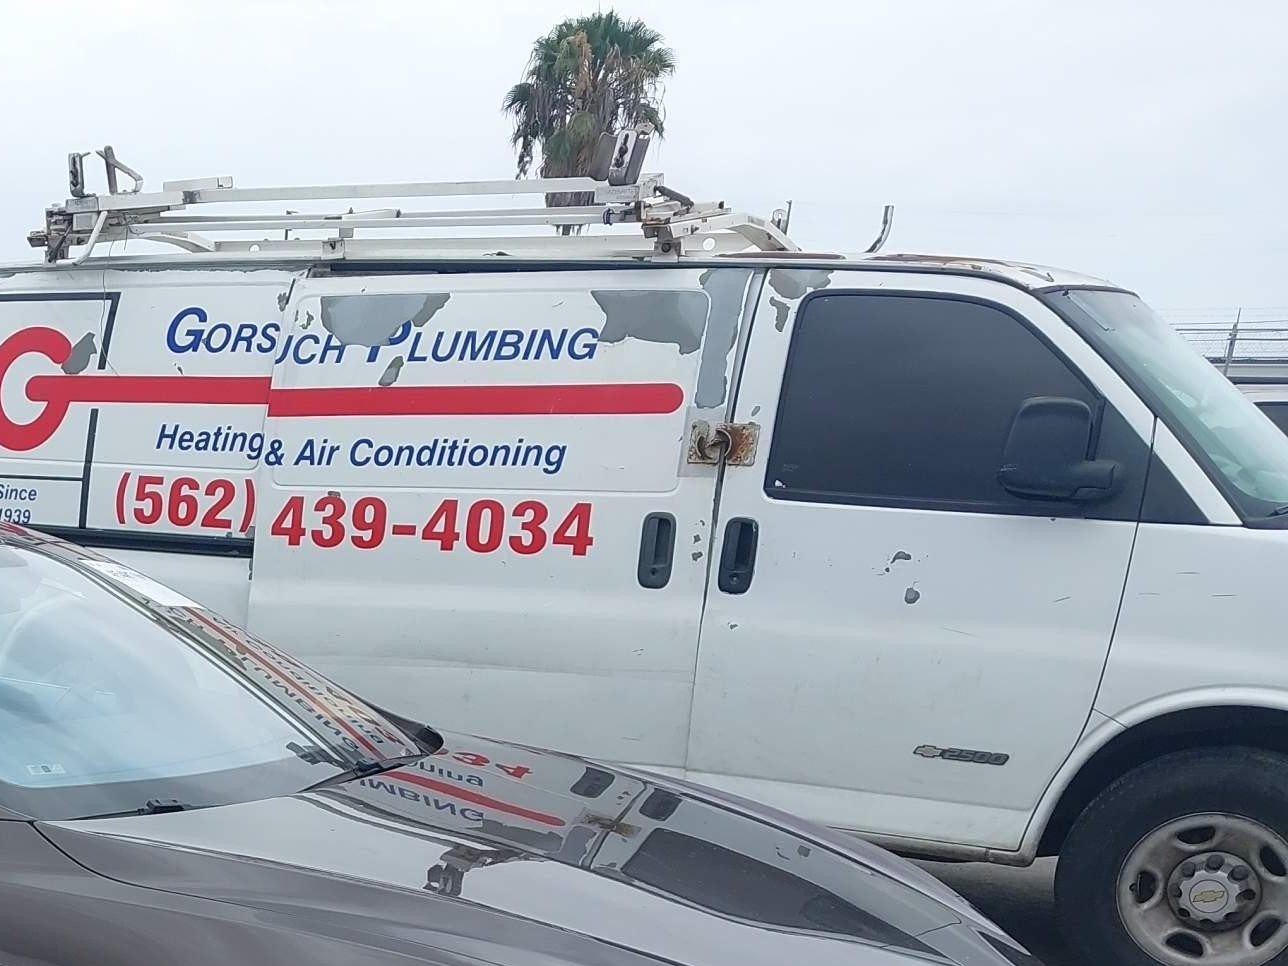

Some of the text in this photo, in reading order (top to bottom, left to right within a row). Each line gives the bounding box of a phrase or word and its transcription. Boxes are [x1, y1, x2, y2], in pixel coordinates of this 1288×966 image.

[155, 424, 568, 475] Heating & Air Conditioning
[115, 472, 595, 557] (562) 439-4034
